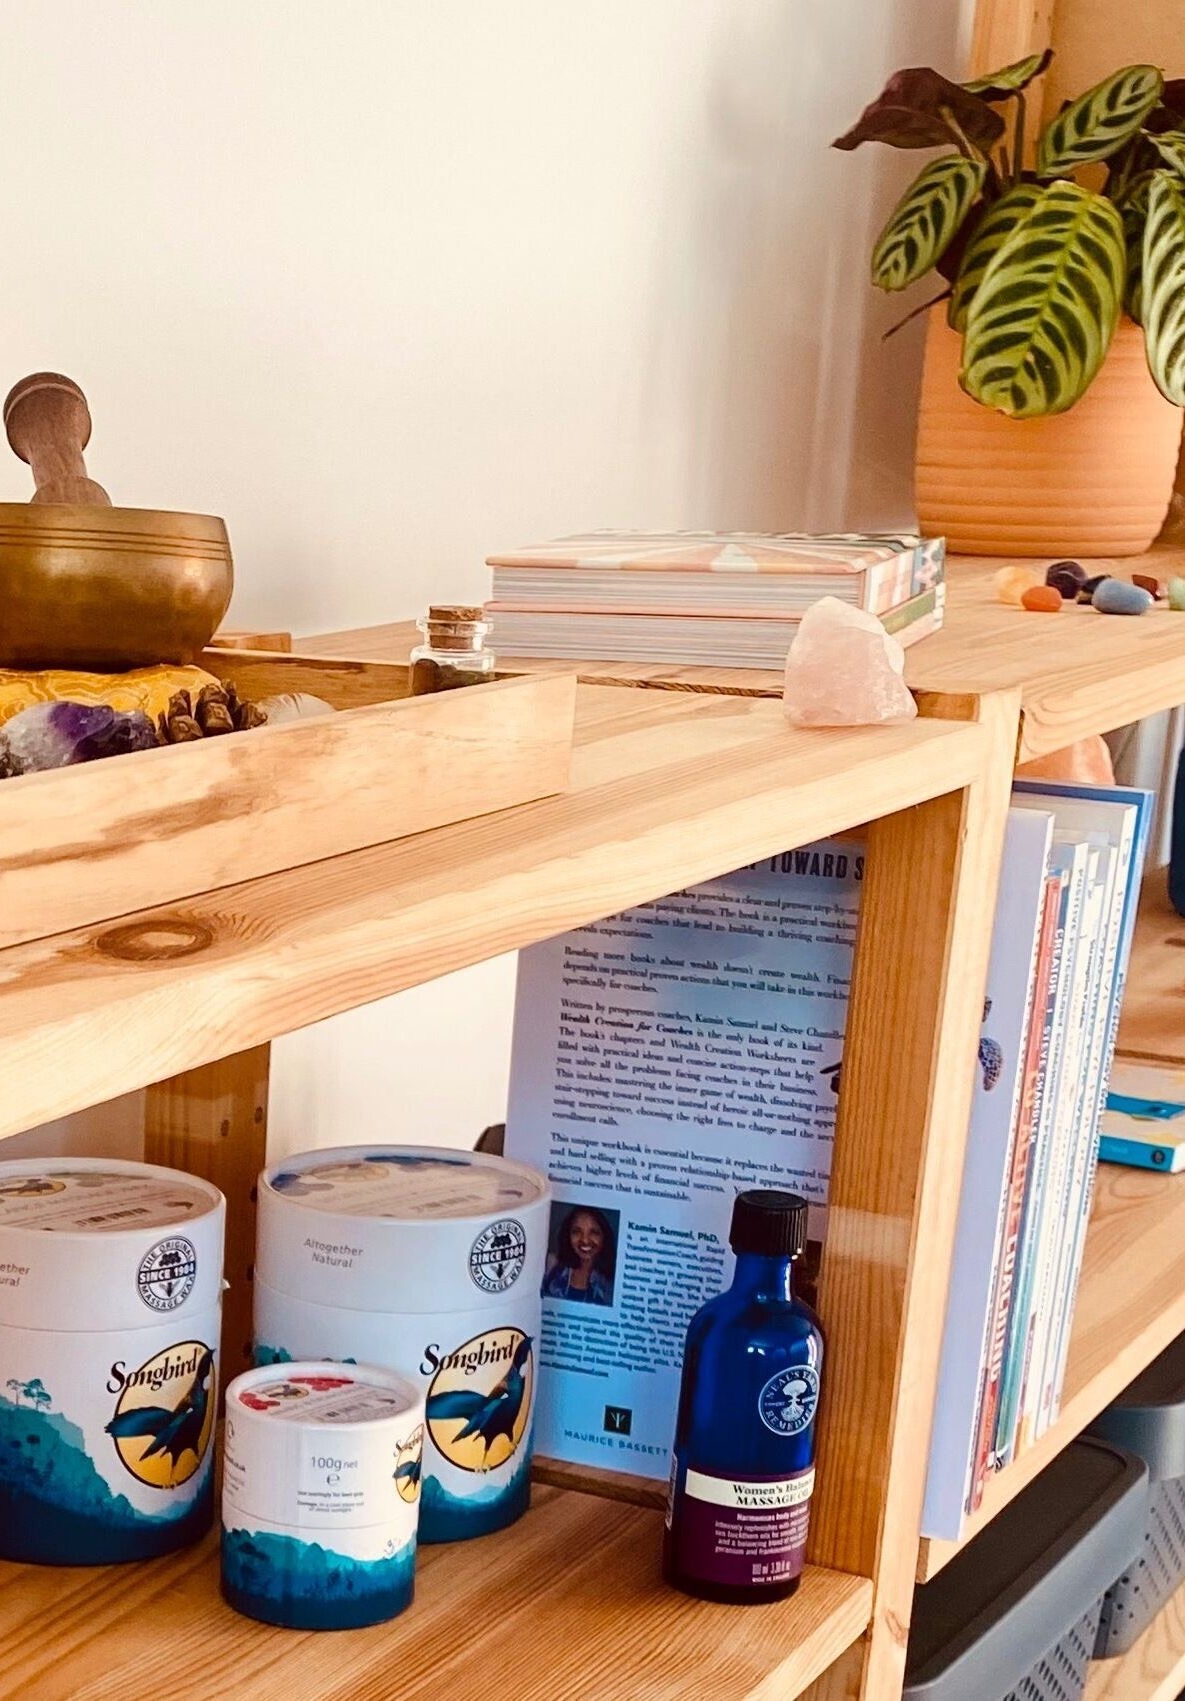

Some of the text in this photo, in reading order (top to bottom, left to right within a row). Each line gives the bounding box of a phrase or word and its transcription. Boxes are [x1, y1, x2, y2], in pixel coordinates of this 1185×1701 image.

[771, 850, 847, 880] TOWARD
[1070, 868, 1084, 933] POSITIVE
[1057, 937, 1074, 1027] PSYCHOLOGY
[560, 1012, 591, 1024] Wealth
[594, 1016, 635, 1029] Creation
[635, 1021, 653, 1033] for
[655, 1023, 694, 1036] Coaches
[1029, 927, 1064, 1144] CREATOR STEVE CHANDLER
[559, 1025, 576, 1037] The
[648, 1037, 667, 1048] and
[670, 1038, 701, 1052] Wealth
[704, 1043, 743, 1057] Creation
[628, 1221, 720, 1244] Kamin Samuel, PhD,
[989, 1070, 1037, 1383] CO-ACTIVE COACHING
[143, 1241, 194, 1270] THE ORIGINAL
[303, 1236, 365, 1258] Altogether
[471, 1250, 502, 1264] SINCE
[139, 1263, 194, 1283] SINCE 1984
[311, 1252, 354, 1270] Natural
[141, 1285, 178, 1308] MASSAGE
[419, 1337, 517, 1377] Songbird
[105, 1347, 198, 1395] Songbird
[564, 1429, 668, 1457] MAURICE BASSETT
[310, 1456, 358, 1472] 100g net
[733, 1484, 783, 1496] Women's
[736, 1494, 795, 1506] MASSAGE
